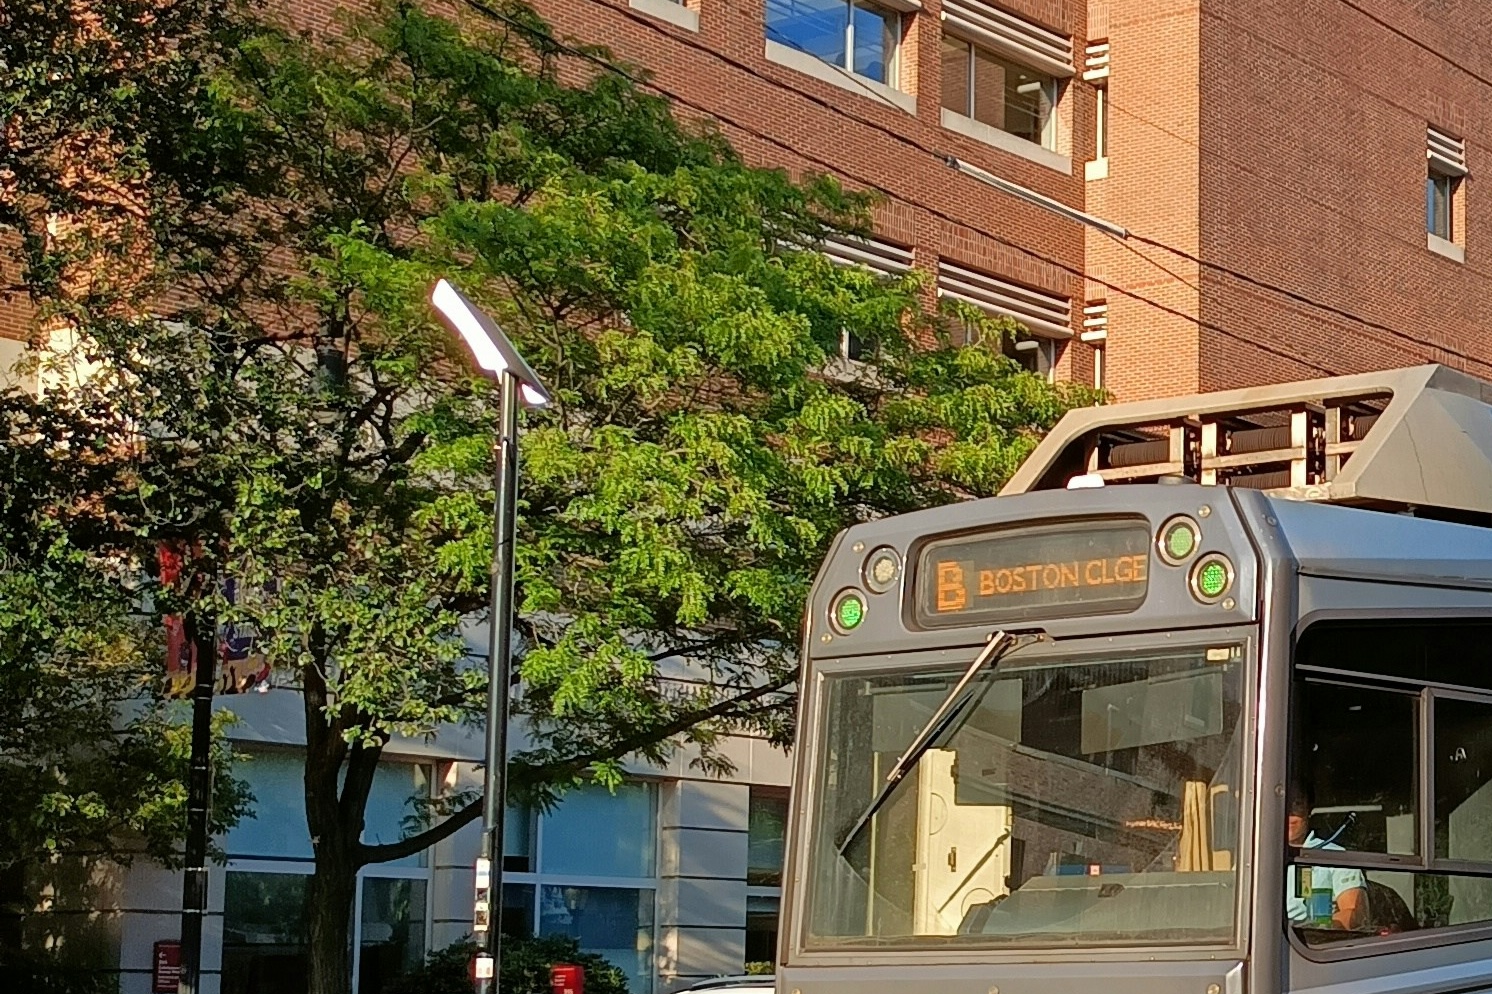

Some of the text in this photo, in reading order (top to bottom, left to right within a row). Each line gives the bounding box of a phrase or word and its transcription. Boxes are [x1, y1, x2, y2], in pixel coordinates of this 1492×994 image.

[936, 554, 1148, 612] B BOSTON CLGE
